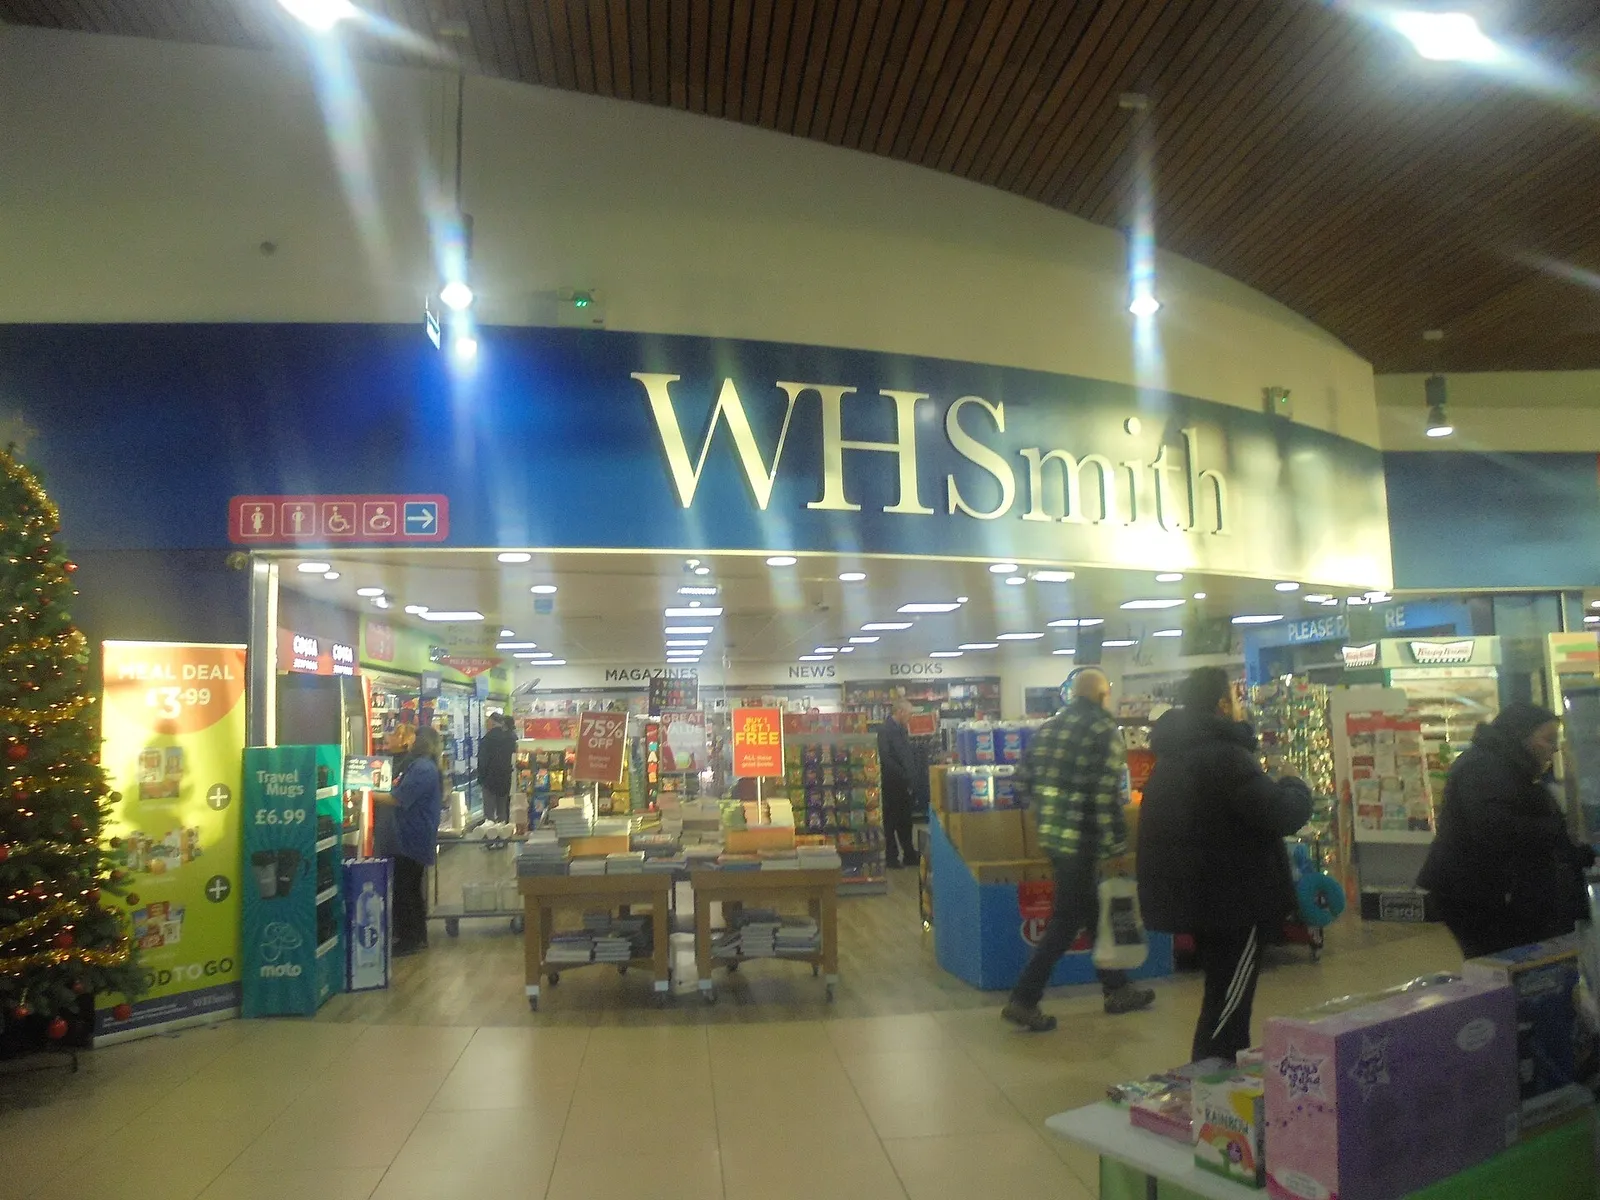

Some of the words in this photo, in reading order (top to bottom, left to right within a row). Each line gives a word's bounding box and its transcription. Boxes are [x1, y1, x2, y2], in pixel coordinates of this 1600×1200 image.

[630, 372, 1230, 536] WHSmith
[1288, 616, 1336, 642] PLEASE
[1385, 606, 1406, 628] RE
[118, 664, 176, 680] MEAL
[182, 664, 235, 680] DEAL
[605, 667, 698, 681] MAGAZINES
[788, 665, 836, 679] NEWS
[889, 662, 943, 676] BOOKS
[662, 713, 703, 725] GREAT
[582, 719, 624, 739] 75%
[743, 723, 763, 733] GET
[588, 737, 613, 749] OFF
[735, 732, 779, 746] FREE
[255, 770, 299, 784] Travel
[266, 782, 305, 797] Mugs
[254, 808, 306, 825] £6.99
[260, 963, 302, 978] moto
